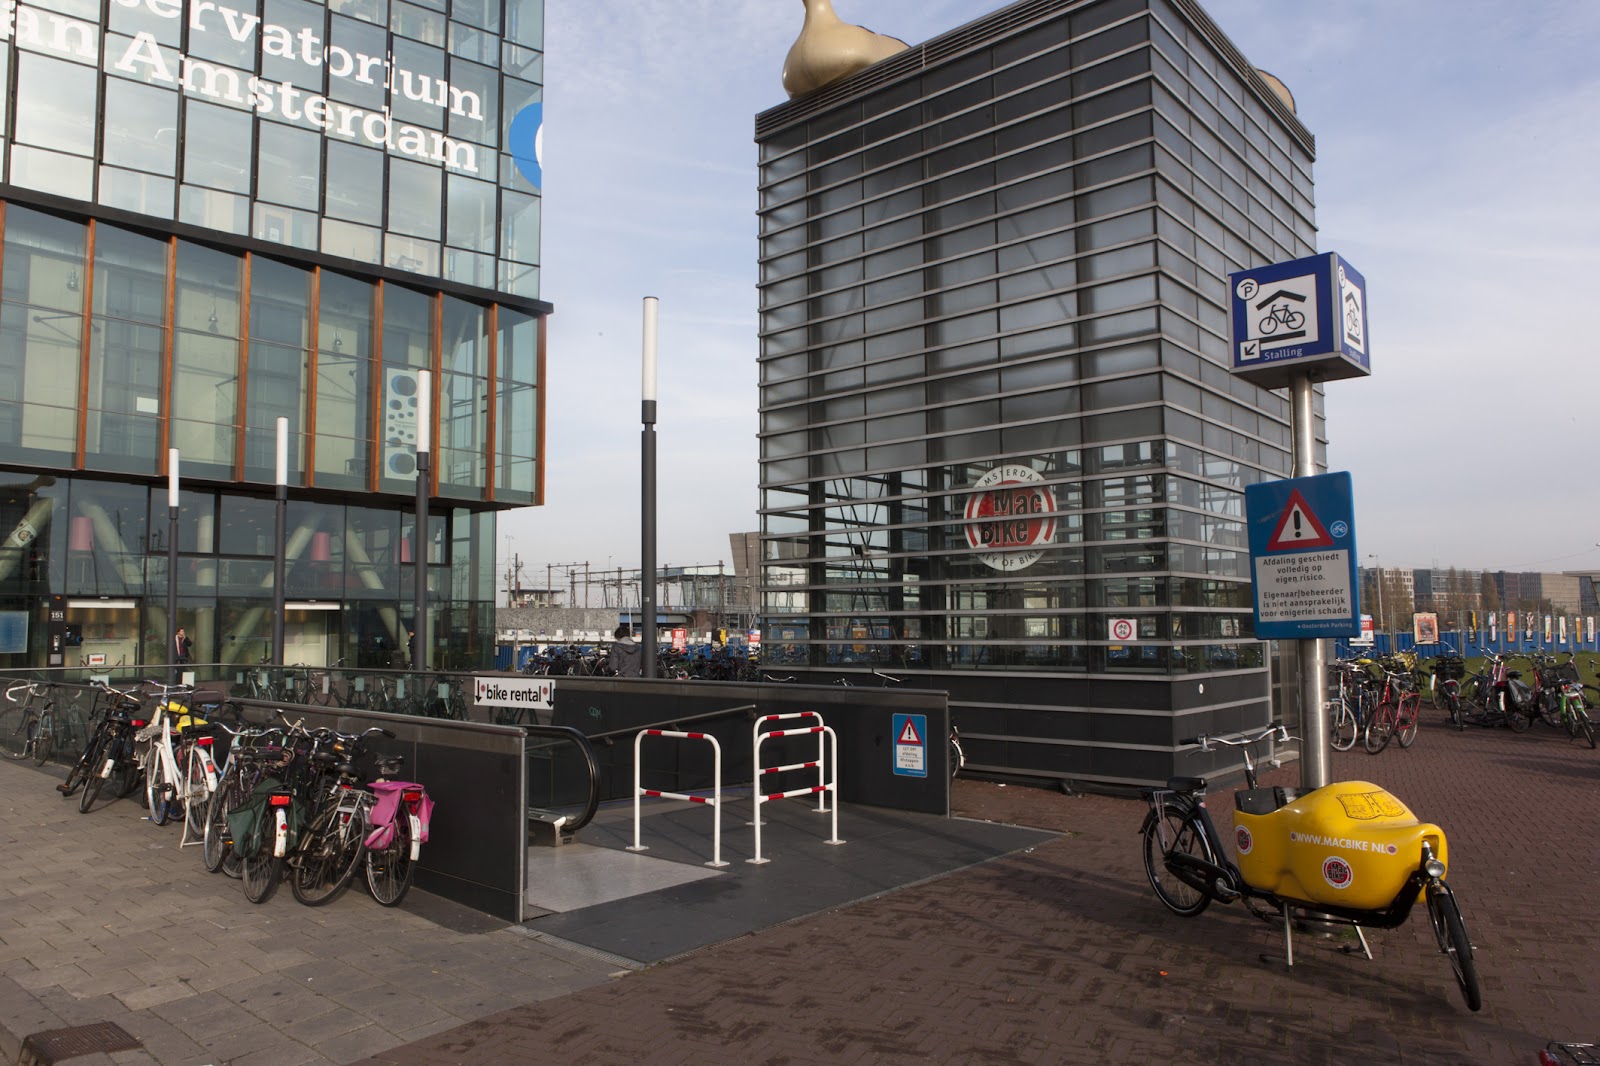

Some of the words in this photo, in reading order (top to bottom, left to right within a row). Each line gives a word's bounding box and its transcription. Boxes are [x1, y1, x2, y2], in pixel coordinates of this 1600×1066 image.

[110, 0, 483, 121] ervatorium
[115, 31, 479, 173] Amsterdam
[1244, 286, 1253, 297] P
[1264, 347, 1303, 361] Stalling
[1264, 558, 1296, 567] Afdaling
[1298, 553, 1340, 564] geschiedt
[1277, 564, 1309, 574] volledig
[1276, 574, 1298, 584] eigen
[1300, 573, 1326, 582] risico.
[1264, 588, 1344, 599] Eigenaar/beheerder
[1263, 600, 1270, 608] is
[1290, 597, 1346, 608] aansprakelijk
[1280, 607, 1316, 618] enigerlei
[486, 684, 508, 700] bike
[510, 686, 541, 702] rental
[1296, 833, 1368, 850] WWW.MACBIKE
[1332, 864, 1348, 874] Mac
[1328, 870, 1344, 880] Bike
